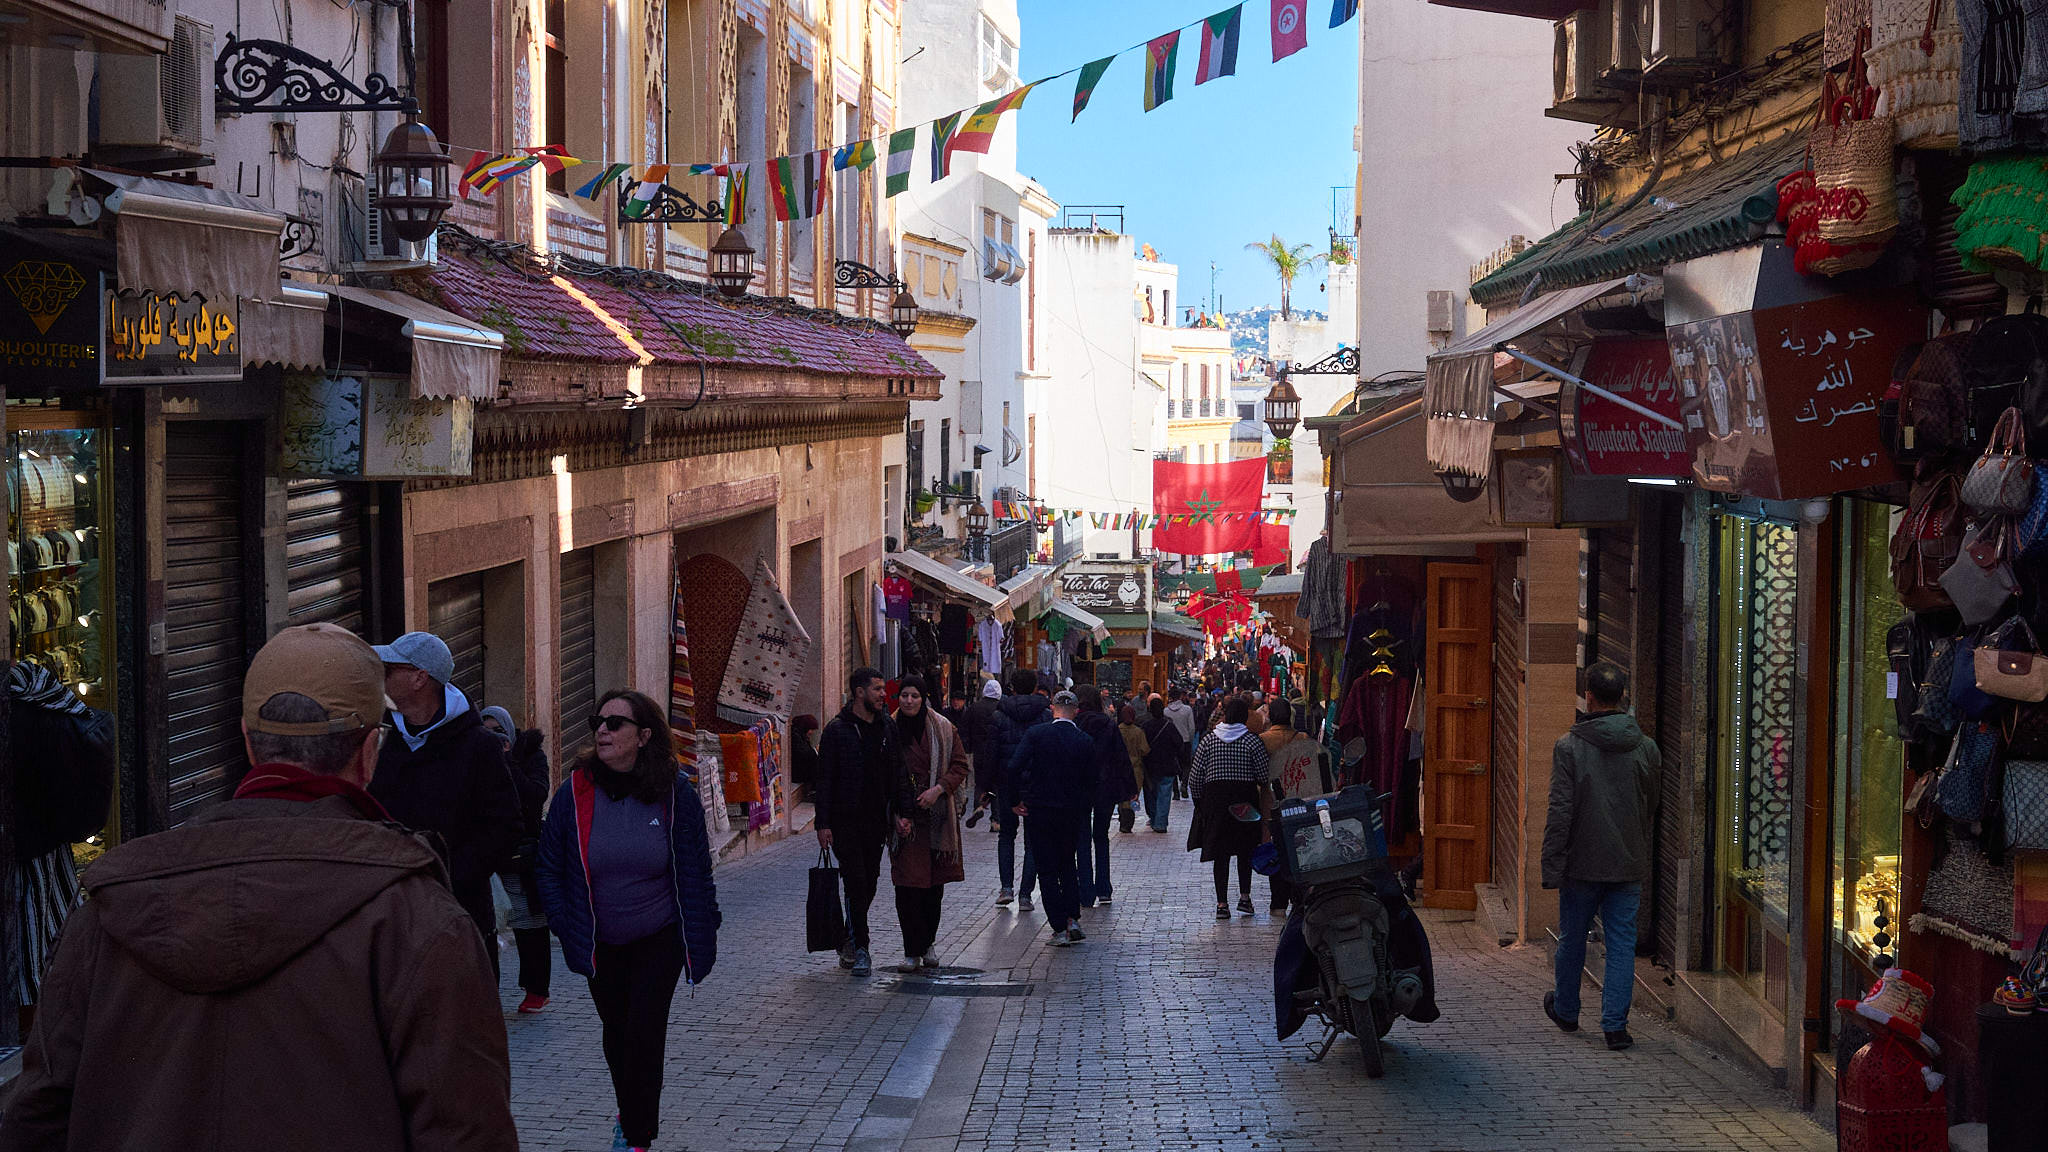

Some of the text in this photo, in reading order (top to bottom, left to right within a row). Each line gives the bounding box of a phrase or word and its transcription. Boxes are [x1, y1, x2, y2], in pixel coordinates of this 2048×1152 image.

[167, 296, 236, 363] جوهرية
[1780, 328, 1875, 357] جوهرية
[7, 356, 77, 369] FLORIA
[1816, 354, 1853, 391] الله
[1583, 421, 1640, 459] Bijouterie
